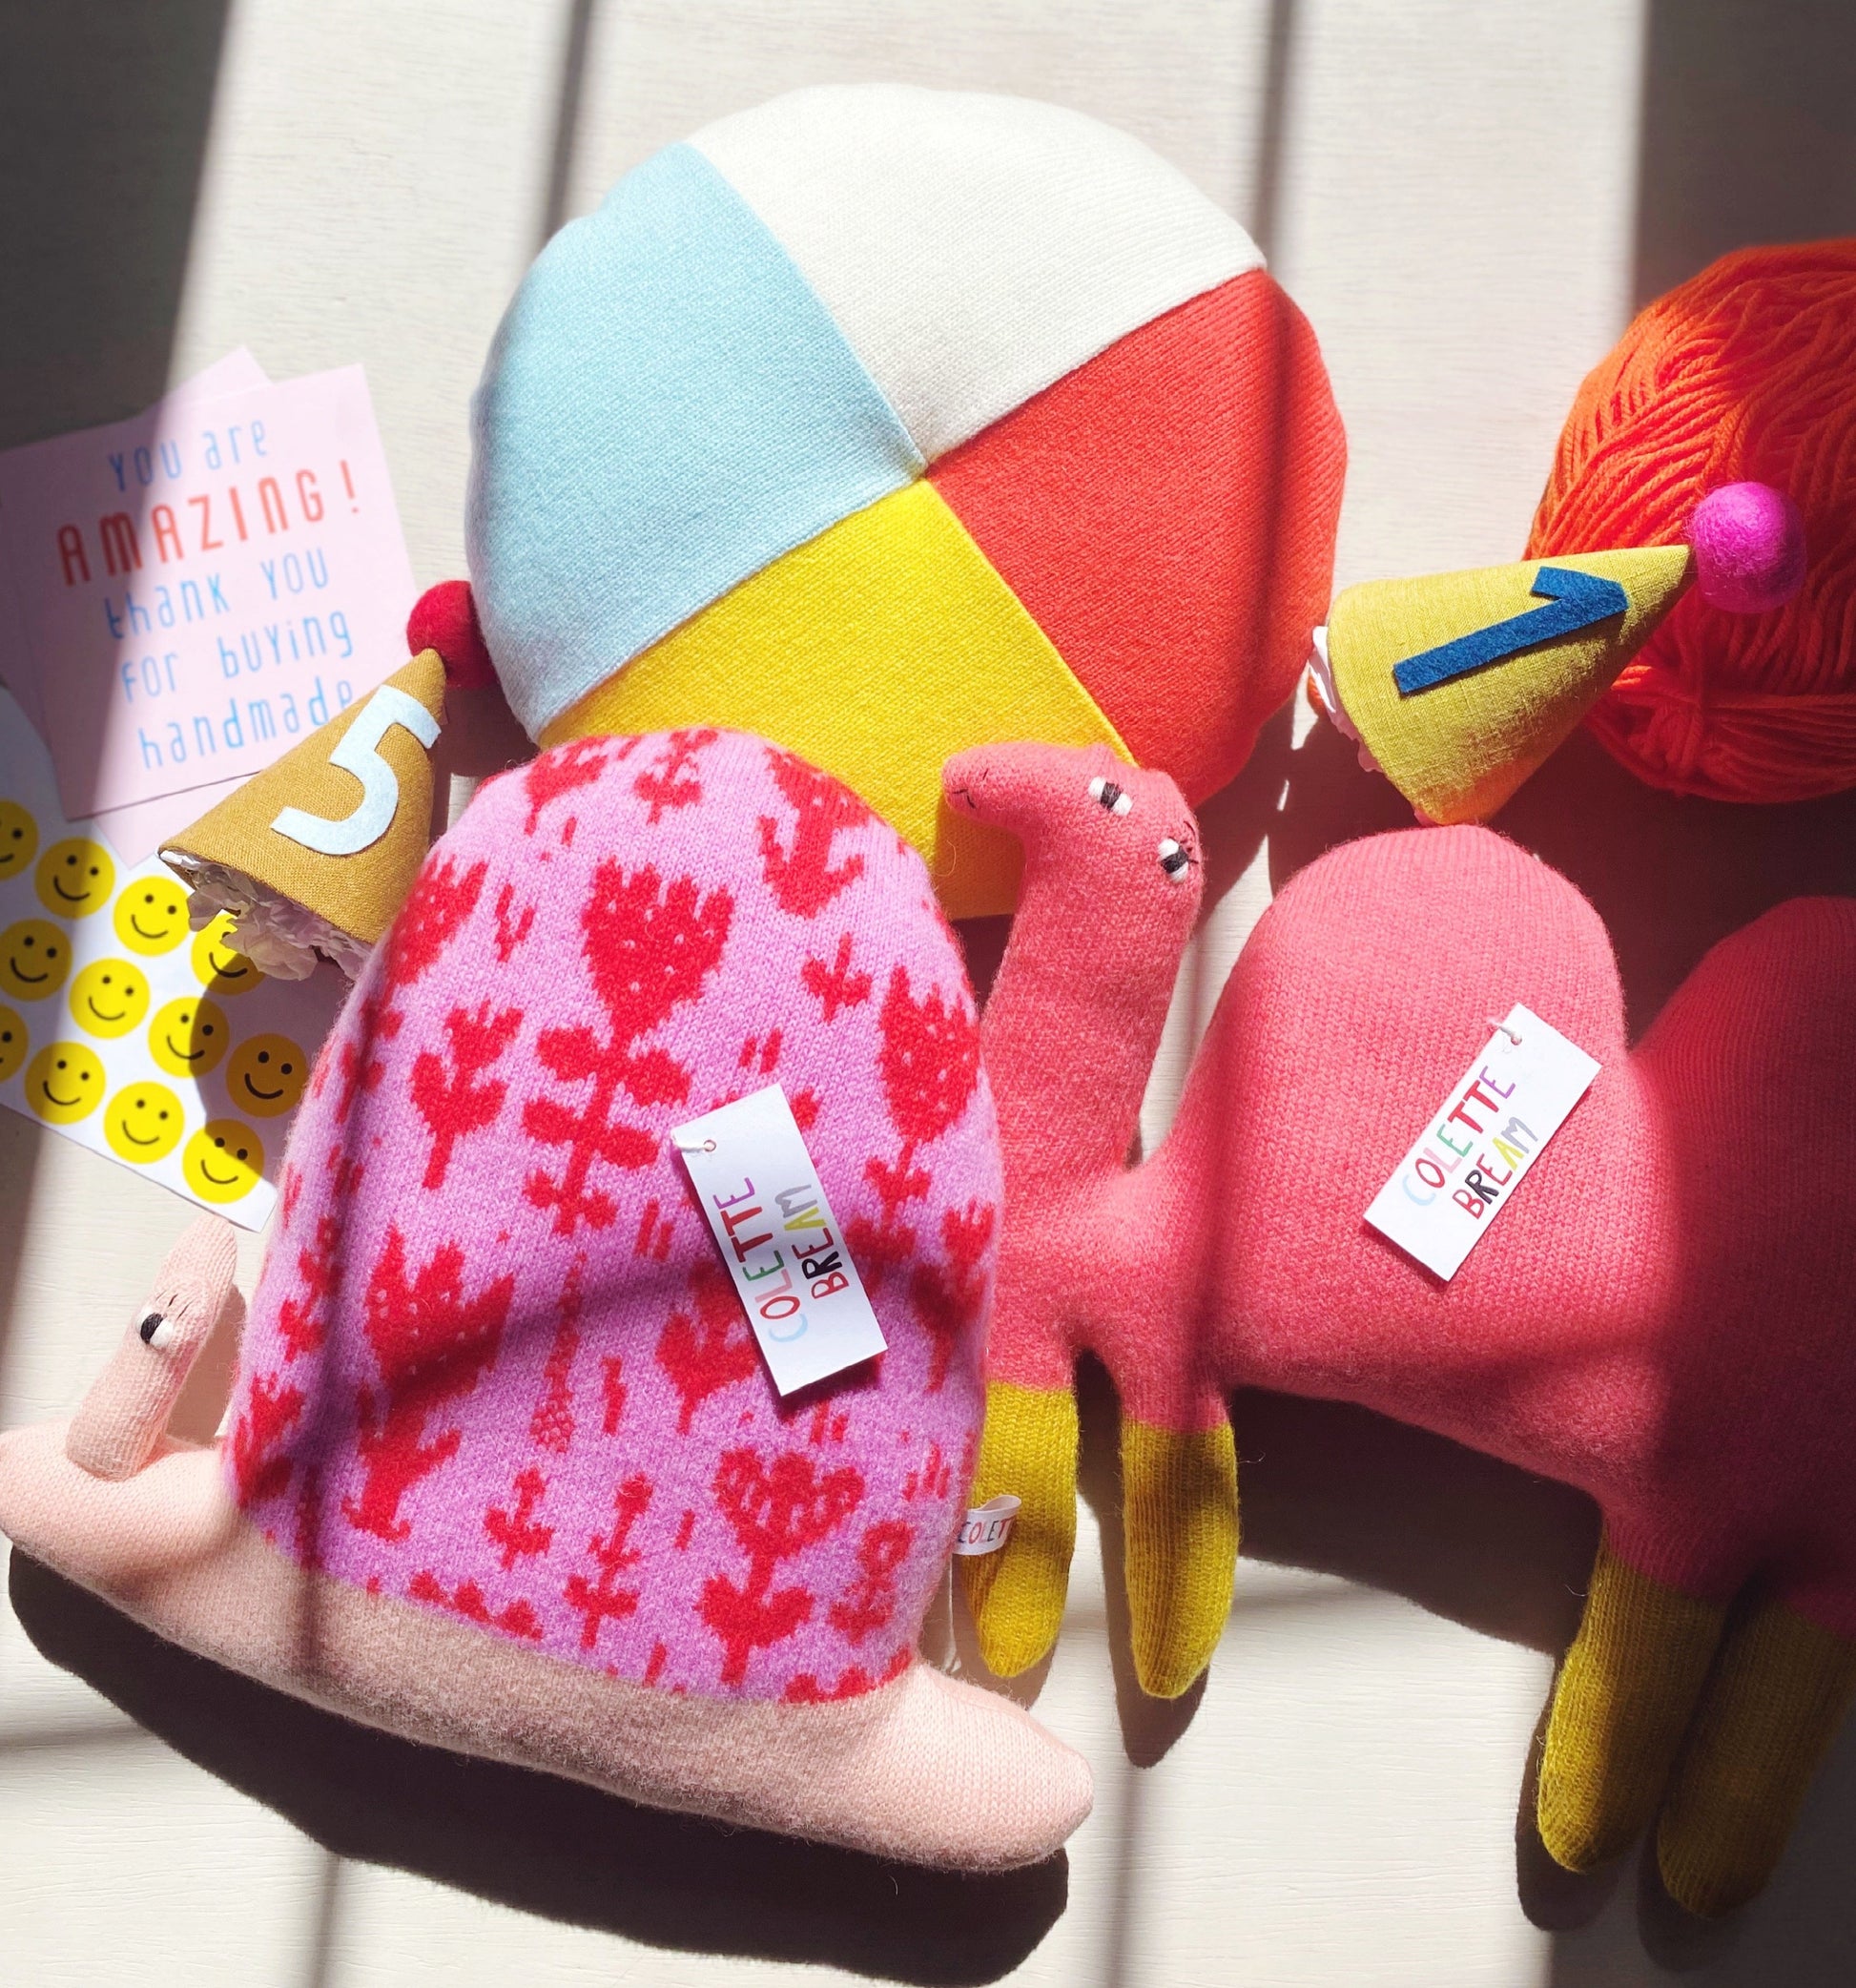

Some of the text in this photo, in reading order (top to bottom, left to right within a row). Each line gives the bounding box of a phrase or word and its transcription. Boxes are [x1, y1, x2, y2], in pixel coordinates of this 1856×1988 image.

[201, 420, 268, 470] are
[104, 572, 230, 640] thank
[1393, 566, 1629, 694] 1
[138, 675, 353, 770] handmade
[271, 684, 442, 855] 5
[1402, 1066, 1516, 1206] COLETTE
[1452, 1116, 1538, 1219] BREAM
[713, 1177, 809, 1343] COLETTE
[774, 1184, 850, 1299] BREAM
